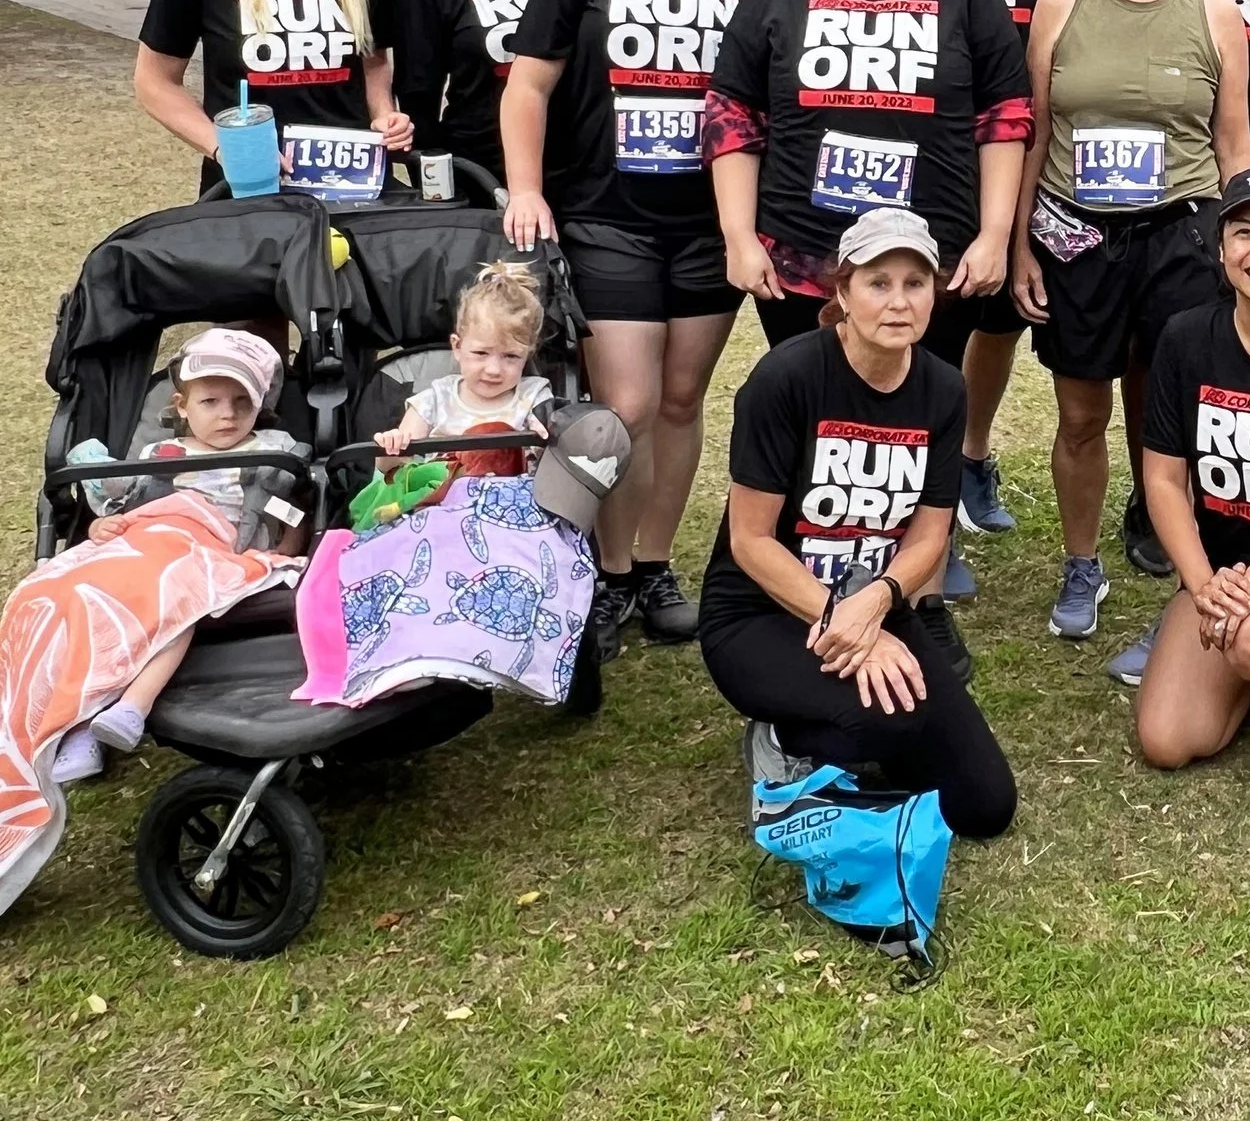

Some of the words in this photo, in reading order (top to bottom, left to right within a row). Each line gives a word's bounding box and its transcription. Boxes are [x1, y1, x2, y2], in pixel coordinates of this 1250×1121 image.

[803, 9, 938, 53] RUN
[242, 32, 355, 72] ORF
[607, 23, 724, 73] ORF
[631, 73, 662, 84] JUNE
[797, 46, 938, 94] ORF
[821, 94, 854, 105] JUNE
[856, 95, 877, 107] 20,
[629, 110, 696, 138] 1359
[298, 139, 371, 170] 1365
[830, 147, 901, 182] 1352
[1085, 141, 1149, 168] 1367
[812, 437, 928, 491] RUN
[802, 485, 921, 531] ORF
[768, 808, 842, 840] GEICO
[781, 824, 832, 851] MILITARY
